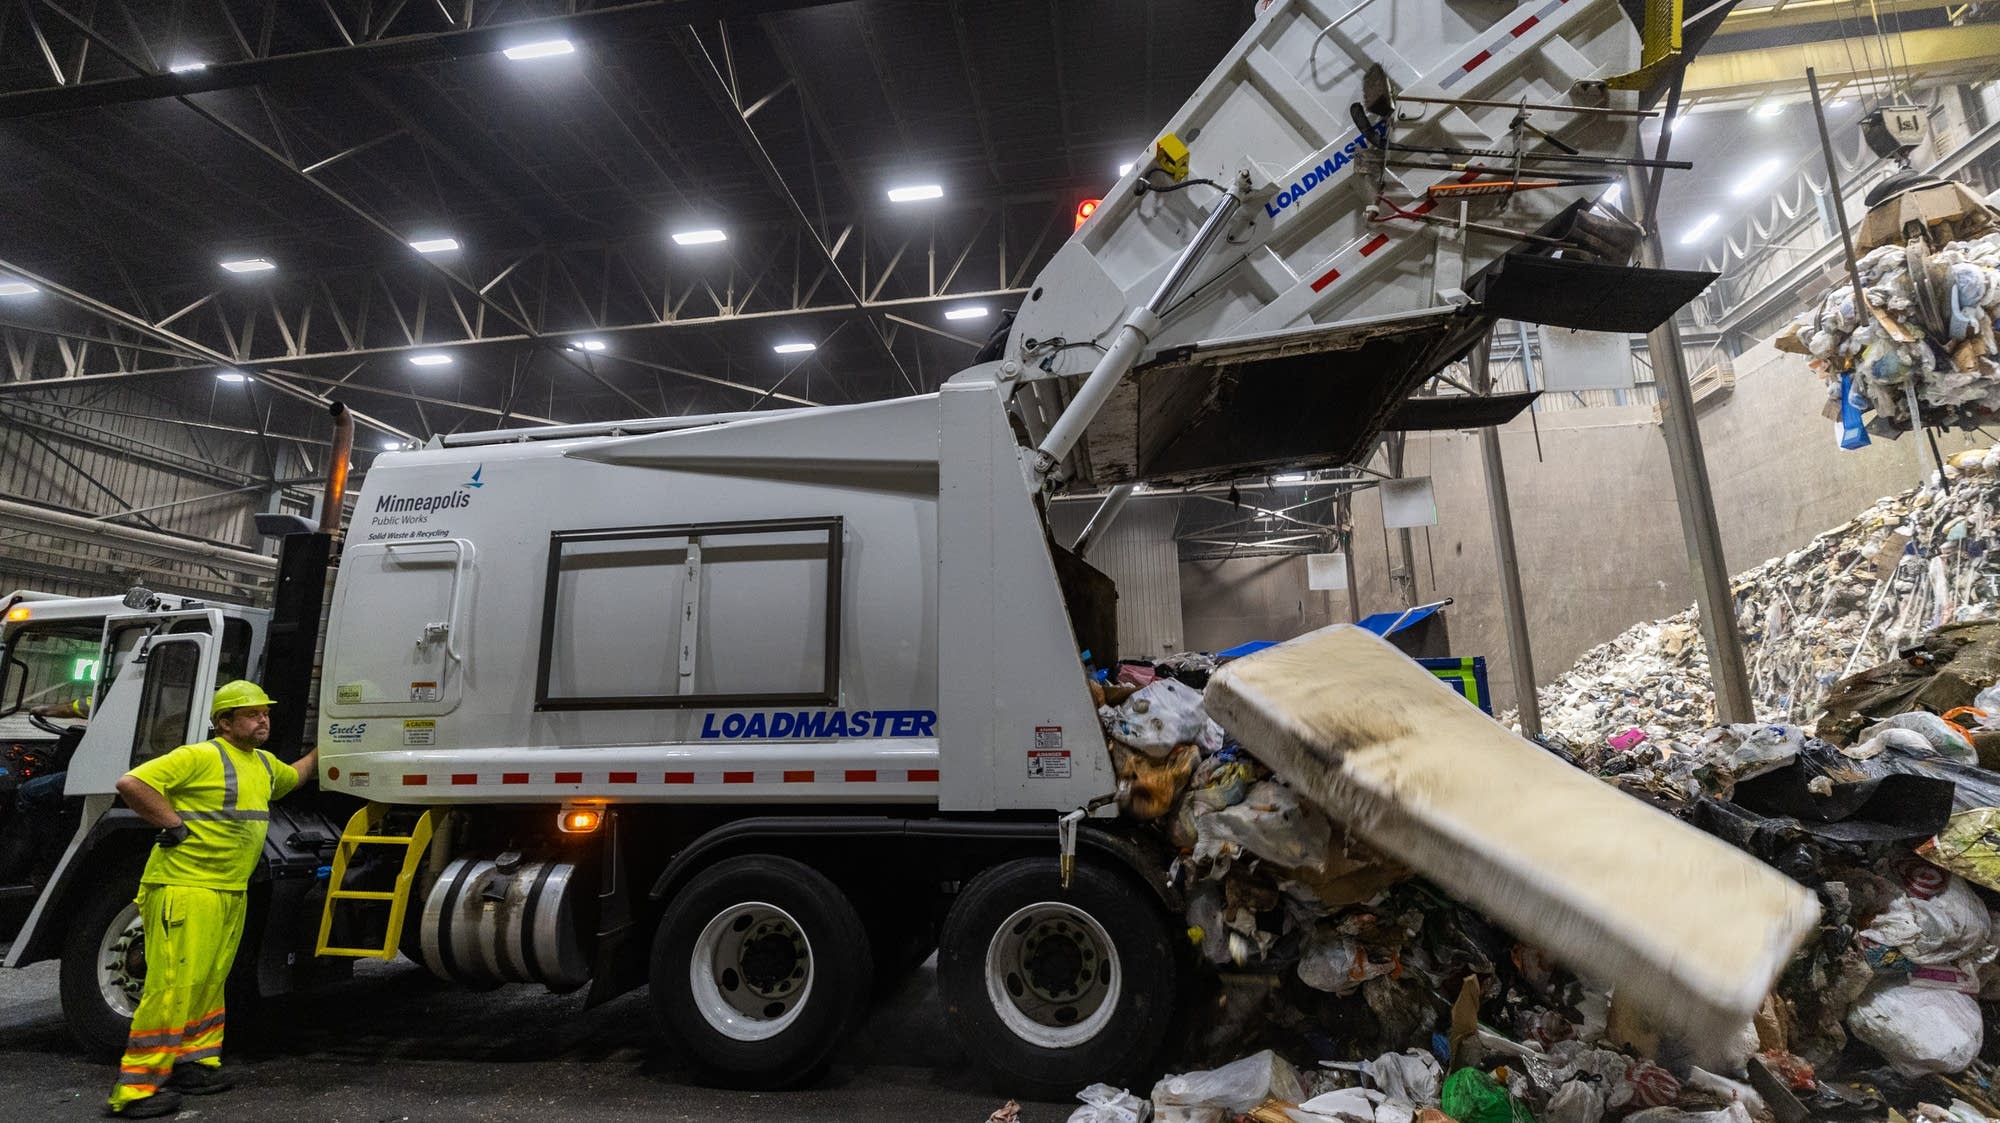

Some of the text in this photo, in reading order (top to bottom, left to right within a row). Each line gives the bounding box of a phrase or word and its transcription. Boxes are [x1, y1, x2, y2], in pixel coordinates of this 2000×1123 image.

[375, 491, 470, 514] Minneapolis
[371, 514, 428, 526] Public Works
[368, 532, 386, 541] Solid
[387, 531, 408, 539] Waste
[416, 529, 449, 538] Recycling
[329, 723, 366, 735] Excel-S
[700, 710, 937, 738] LOADMASTER
